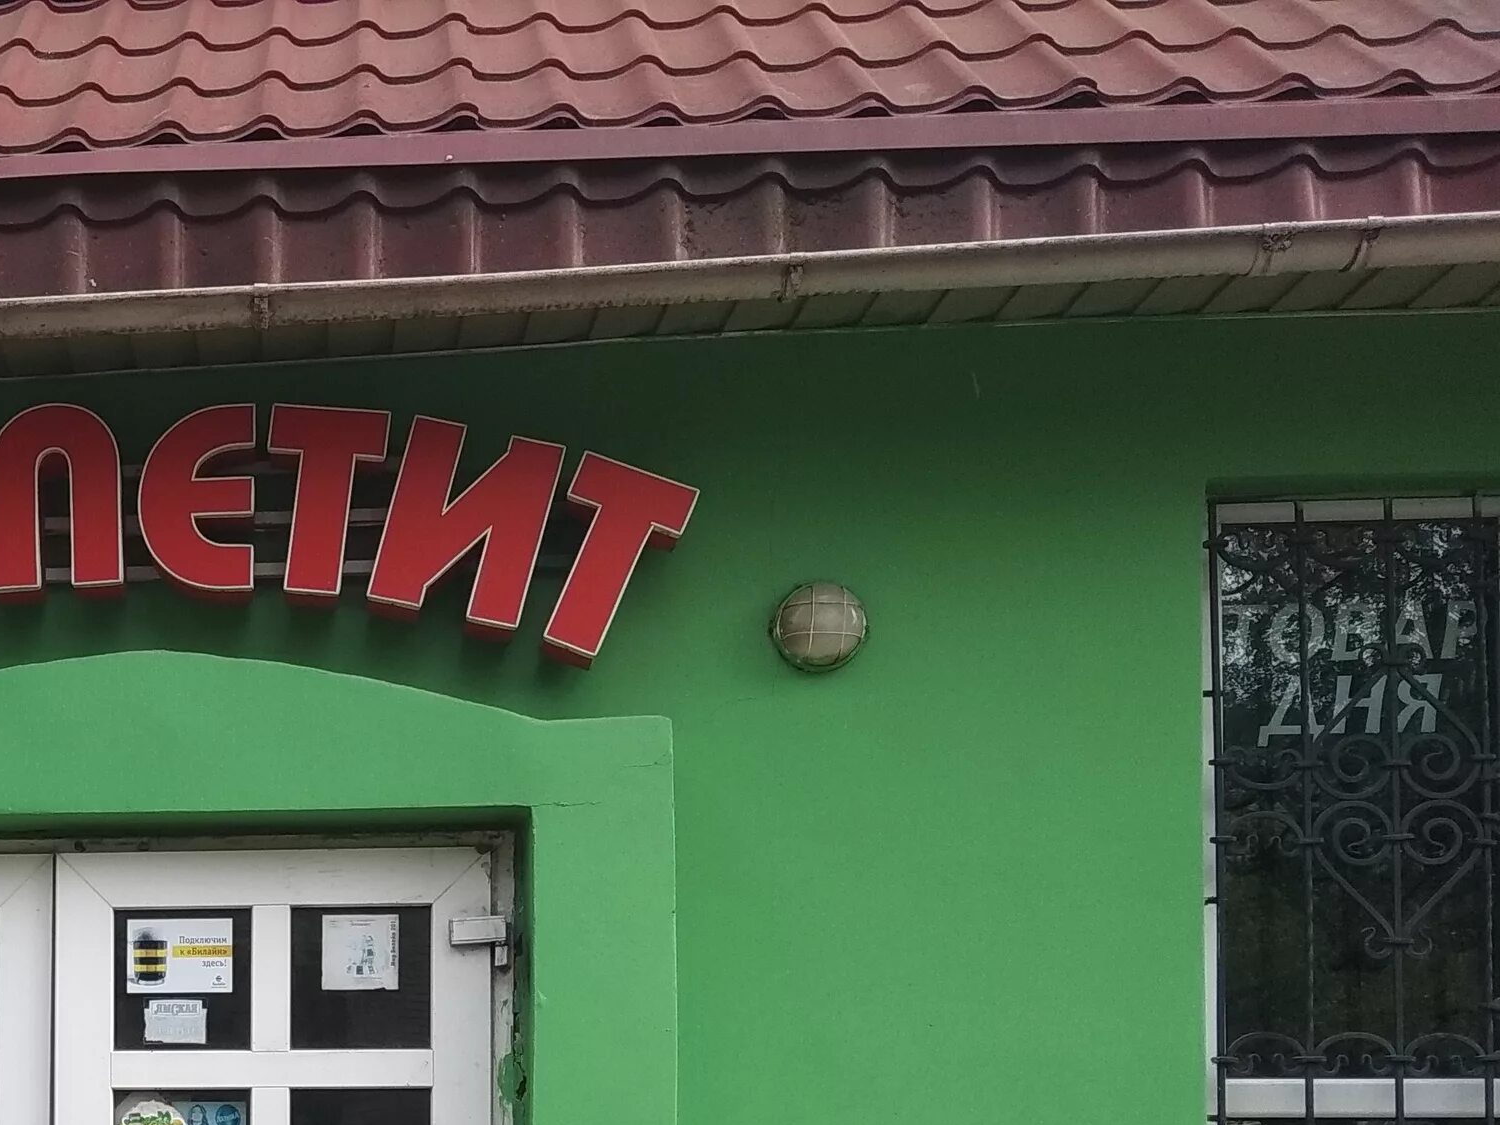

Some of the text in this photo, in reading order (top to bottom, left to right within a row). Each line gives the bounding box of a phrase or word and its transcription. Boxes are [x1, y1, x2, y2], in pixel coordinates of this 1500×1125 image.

[1256, 673, 1443, 748] ДНЯ
[178, 935, 228, 945] Подключим
[187, 947, 228, 957] «Билайн»
[201, 959, 228, 968] здесь!
[154, 1003, 198, 1016] ЯМСКАЯ
